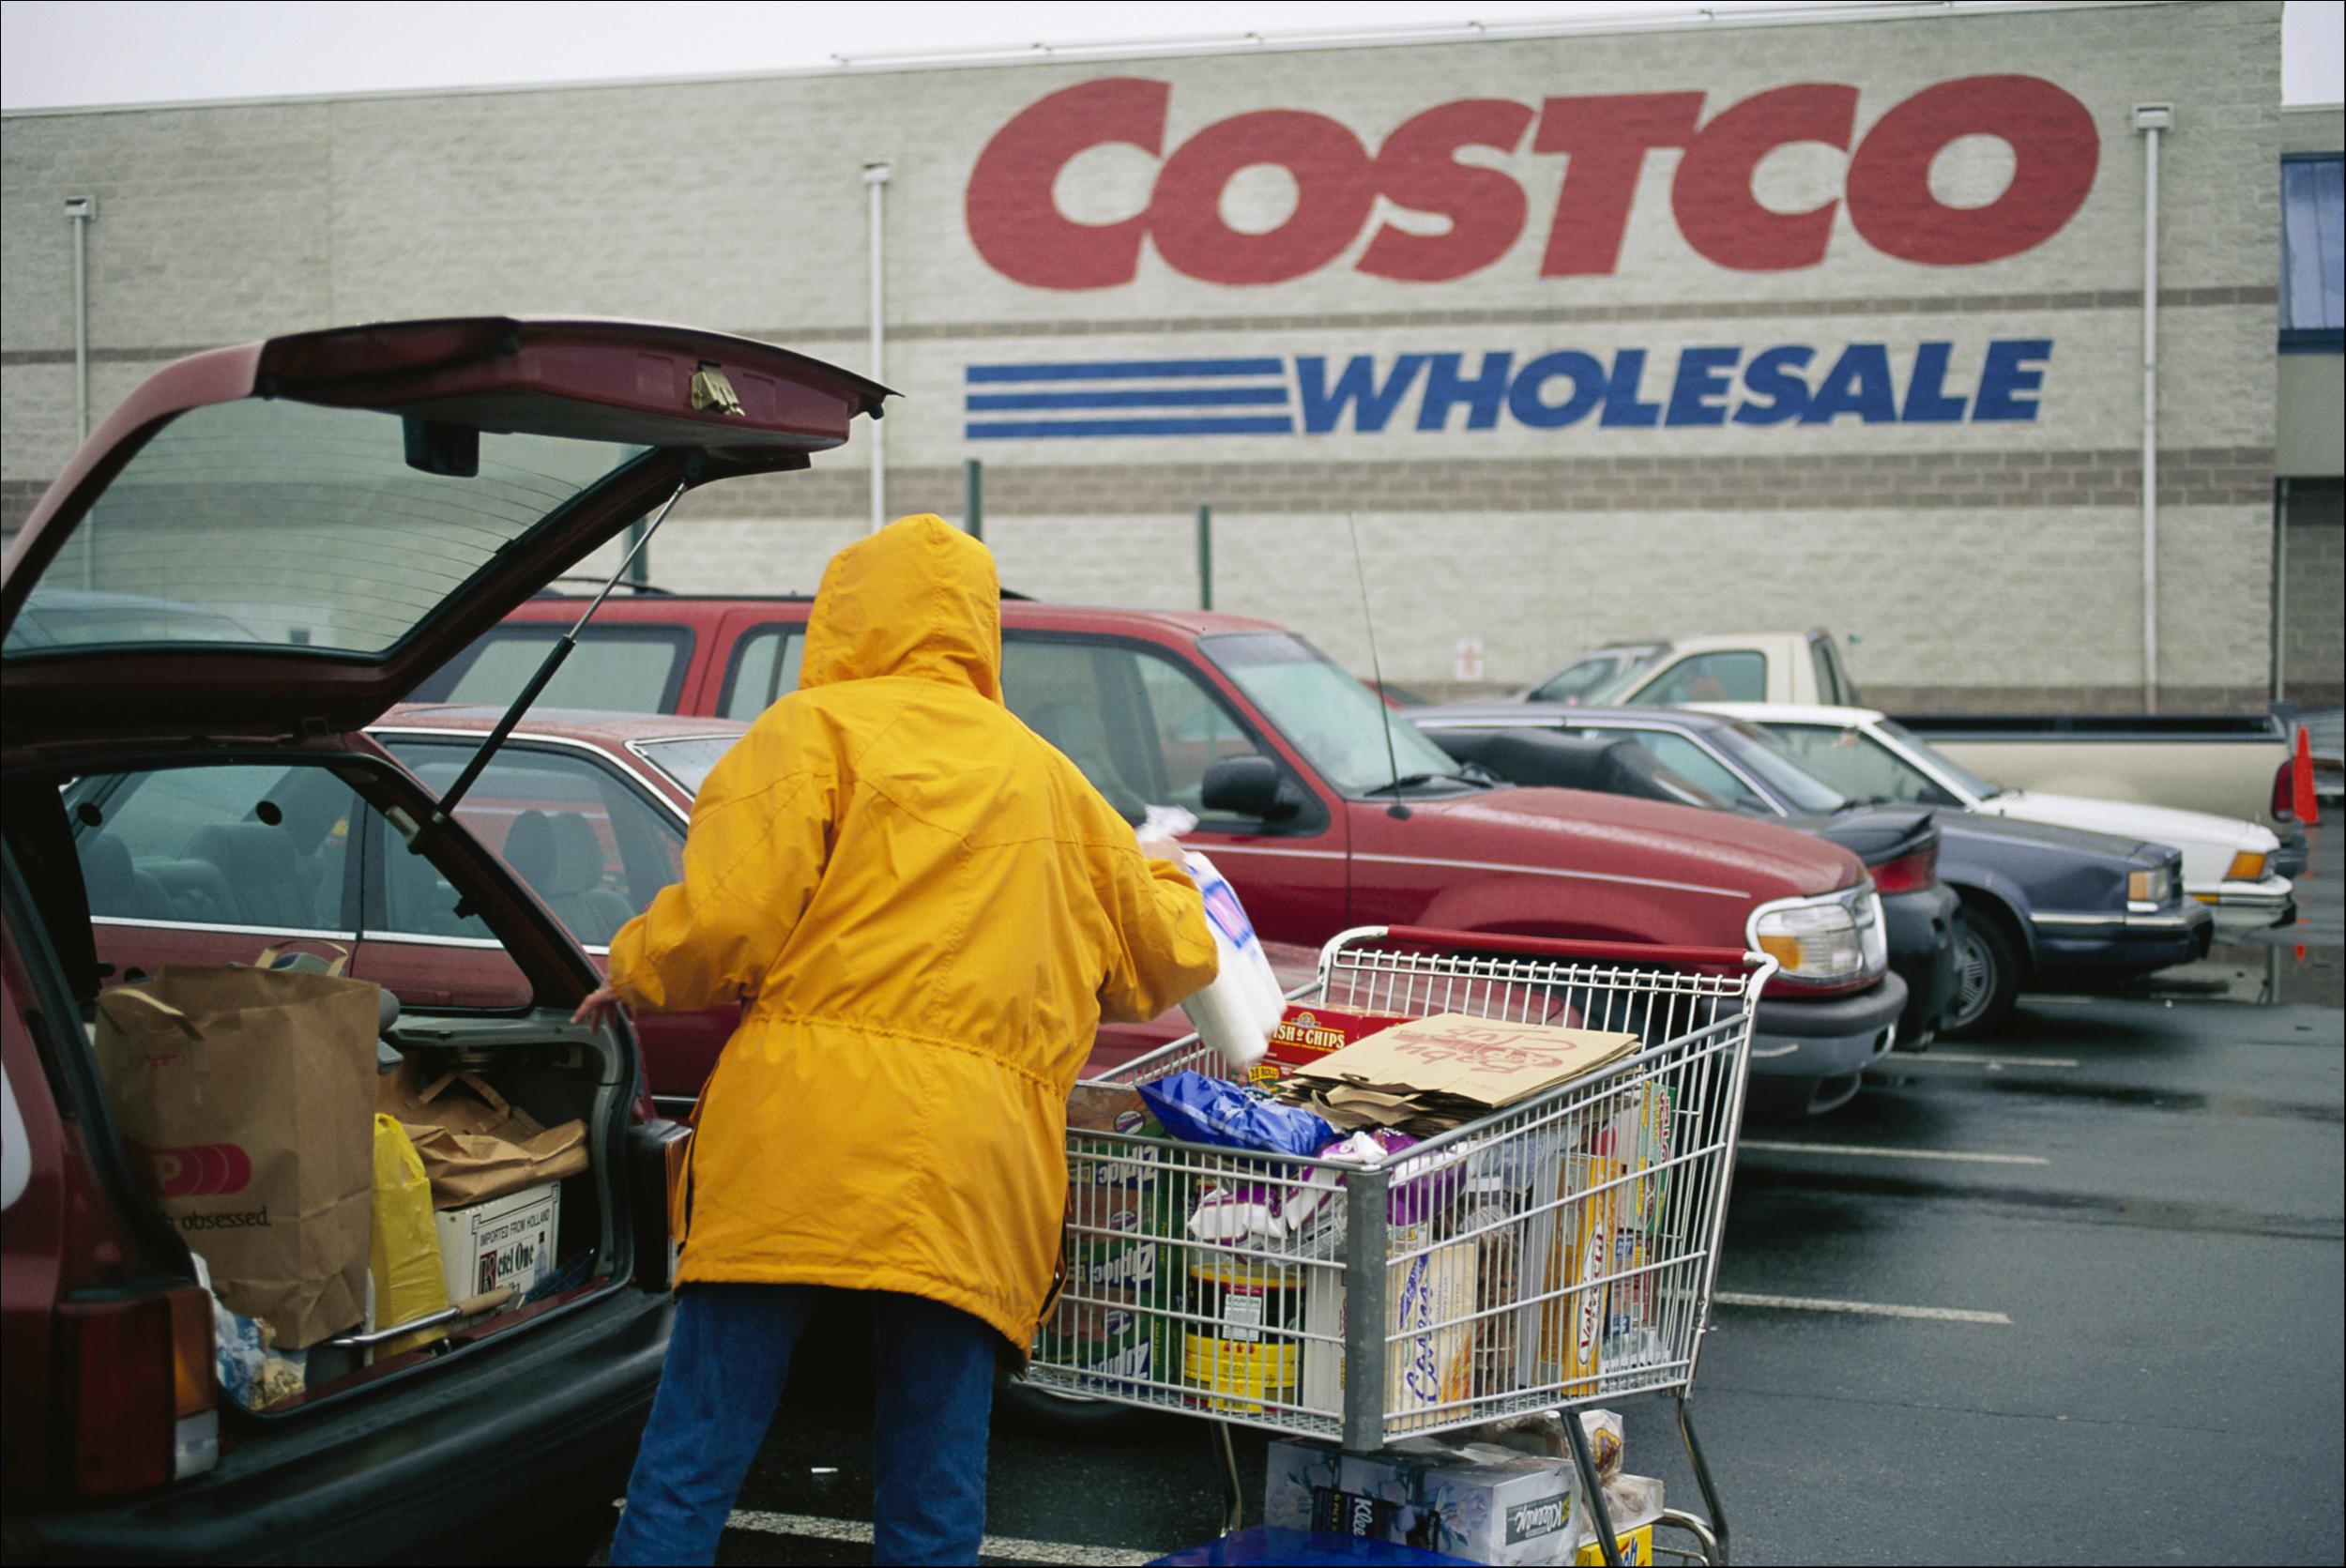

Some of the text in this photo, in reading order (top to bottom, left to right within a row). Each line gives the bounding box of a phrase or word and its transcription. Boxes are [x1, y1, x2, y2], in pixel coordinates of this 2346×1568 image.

[965, 73, 2100, 291] COSTCO
[1293, 339, 2054, 434] WHOLESALE
[1304, 1030, 1345, 1049] CHIPS
[181, 1204, 272, 1230] obsessed.
[480, 1209, 550, 1247] IMPORTED FROM HOLLAND
[1092, 1243, 1155, 1284] Ziploc
[1352, 1497, 1373, 1537] Klee
[1515, 1500, 1562, 1533] Kleenex
